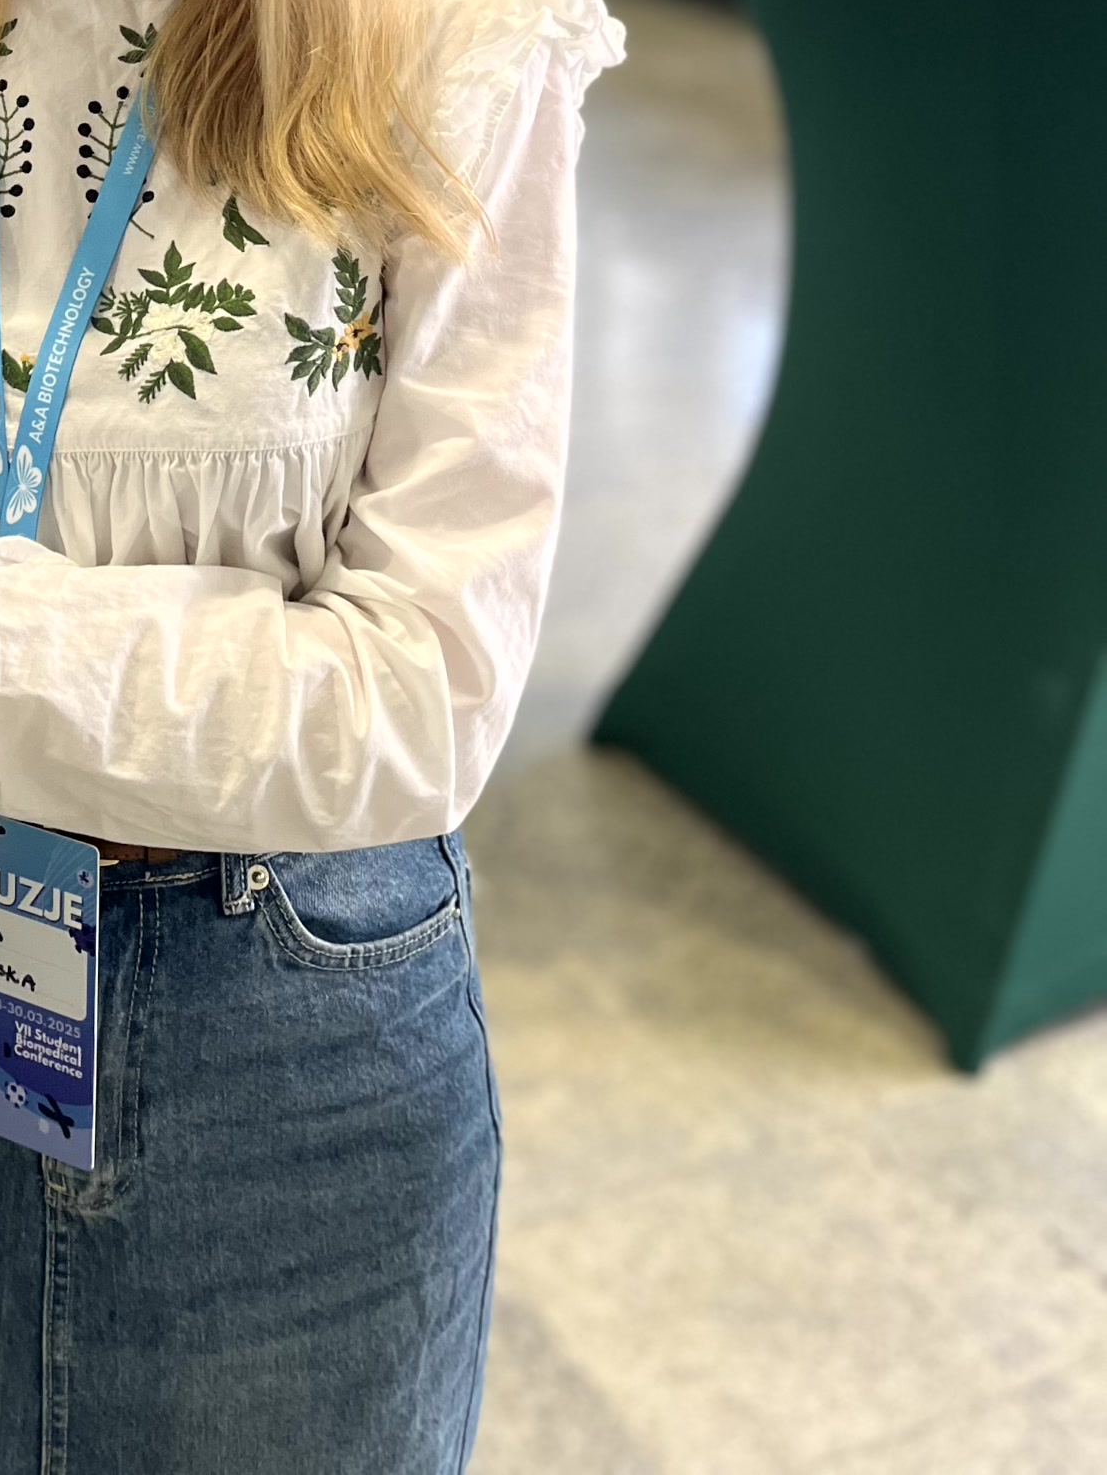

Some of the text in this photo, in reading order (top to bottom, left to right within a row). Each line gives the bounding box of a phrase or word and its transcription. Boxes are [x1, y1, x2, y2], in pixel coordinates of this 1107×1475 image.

[29, 266, 96, 444] A&A BIOTECHNOLOGY
[15, 1020, 82, 1056] VII Student
[15, 1033, 82, 1067] Biomedical
[14, 1044, 83, 1079] Conference
